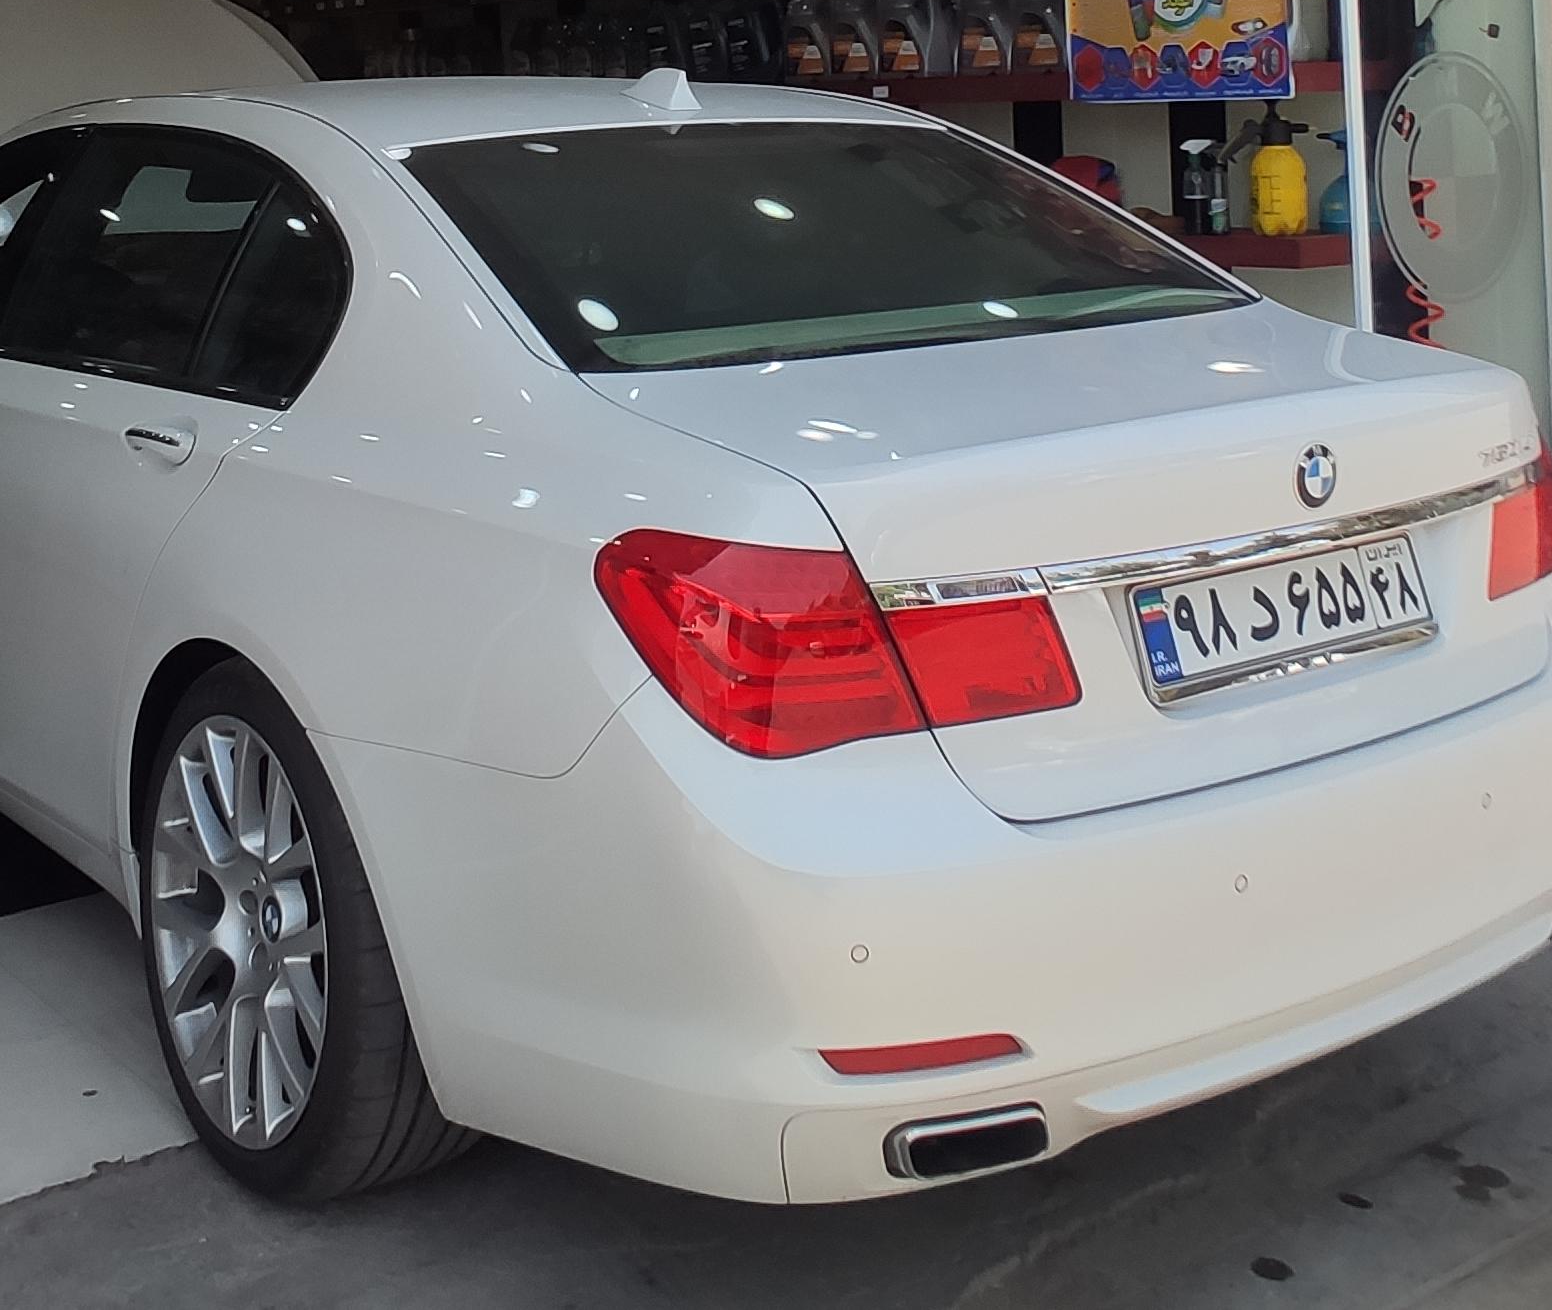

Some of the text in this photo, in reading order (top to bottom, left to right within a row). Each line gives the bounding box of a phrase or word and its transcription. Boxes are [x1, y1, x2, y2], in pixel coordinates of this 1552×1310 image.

[1364, 543, 1404, 562] ایران
[1173, 561, 1422, 658] ۹۸ د ۶۵۵ ۴۸
[1154, 660, 1181, 677] IRAN
